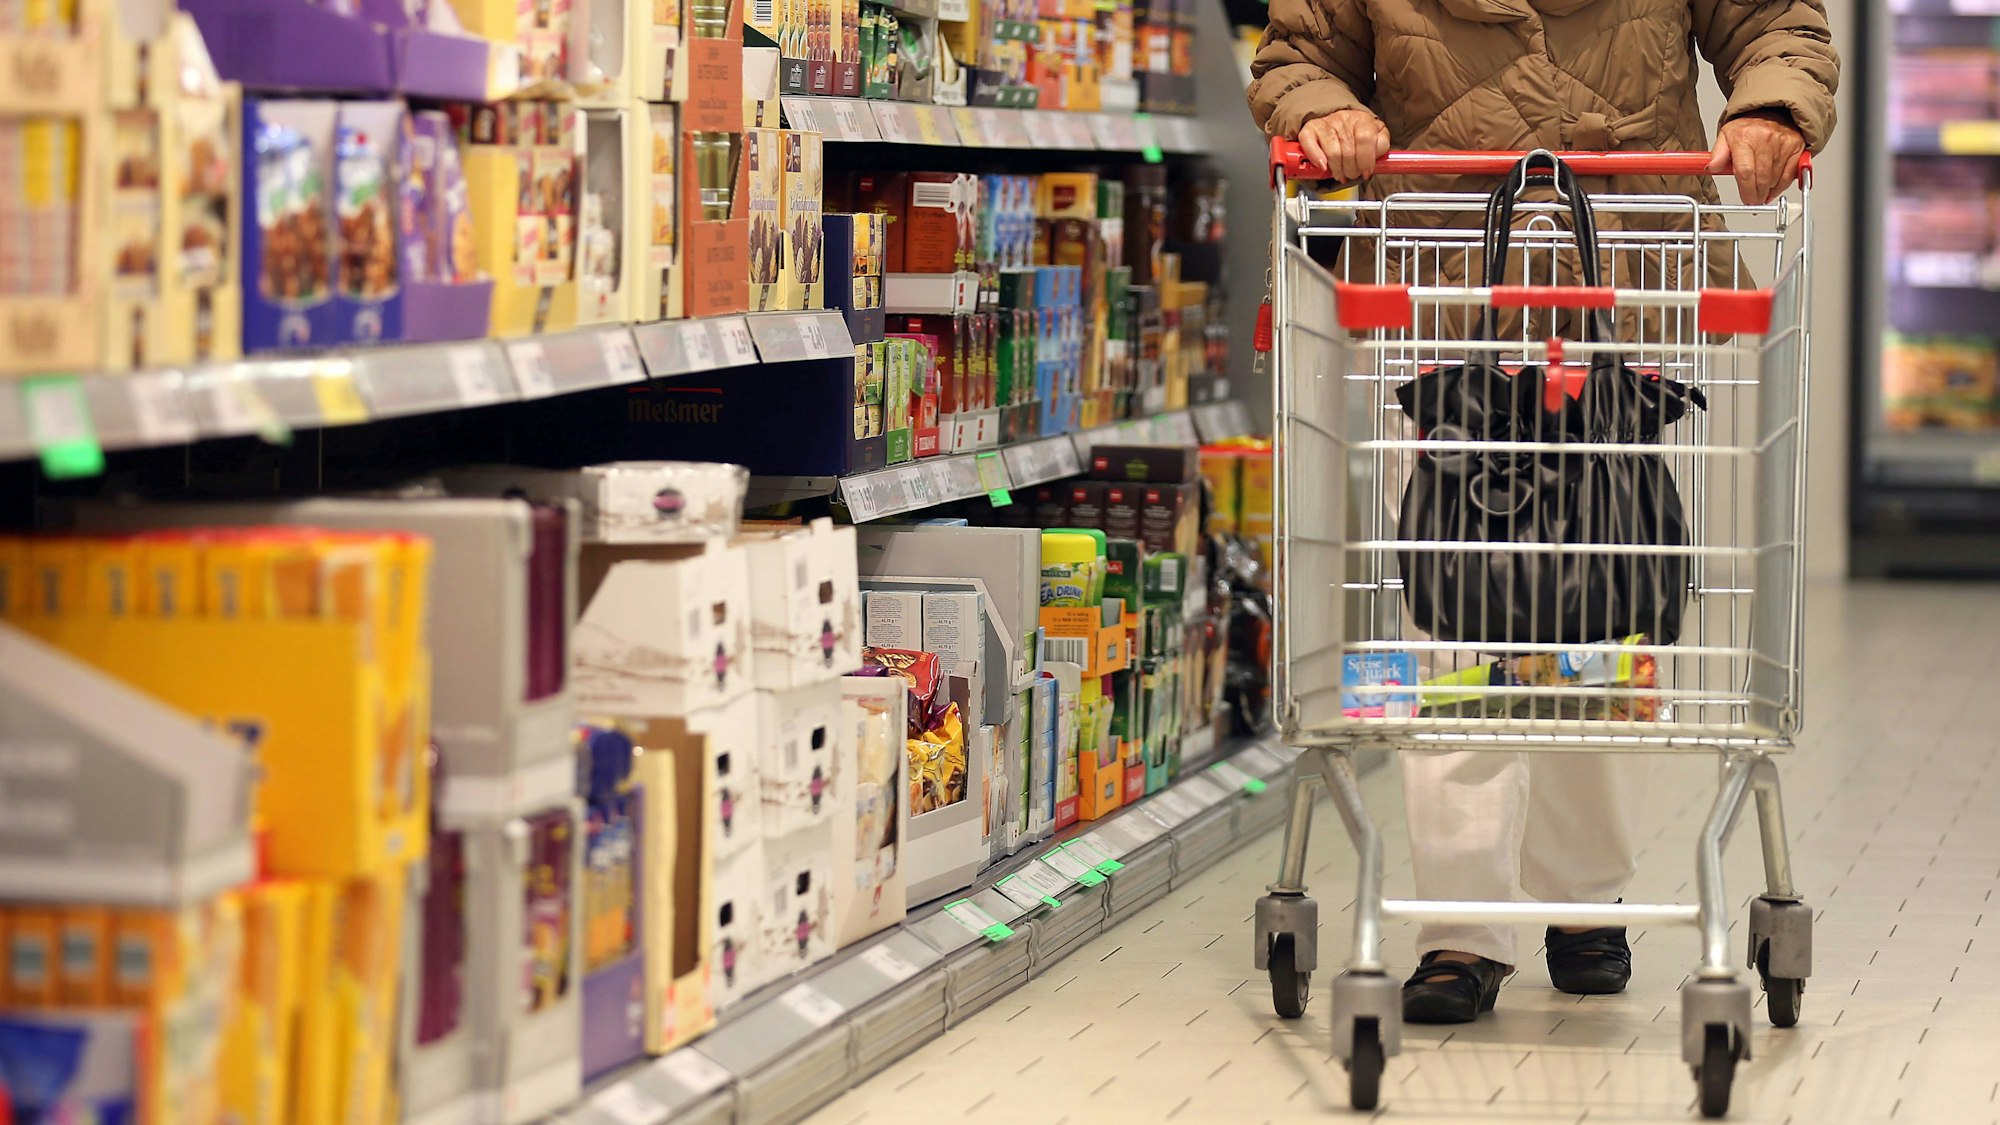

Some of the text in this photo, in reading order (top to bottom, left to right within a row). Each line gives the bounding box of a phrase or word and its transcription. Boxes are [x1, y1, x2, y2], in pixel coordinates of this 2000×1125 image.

[627, 398, 724, 423] Meßmer
[1056, 585, 1084, 600] DRINK
[1347, 657, 1383, 673] Speise
